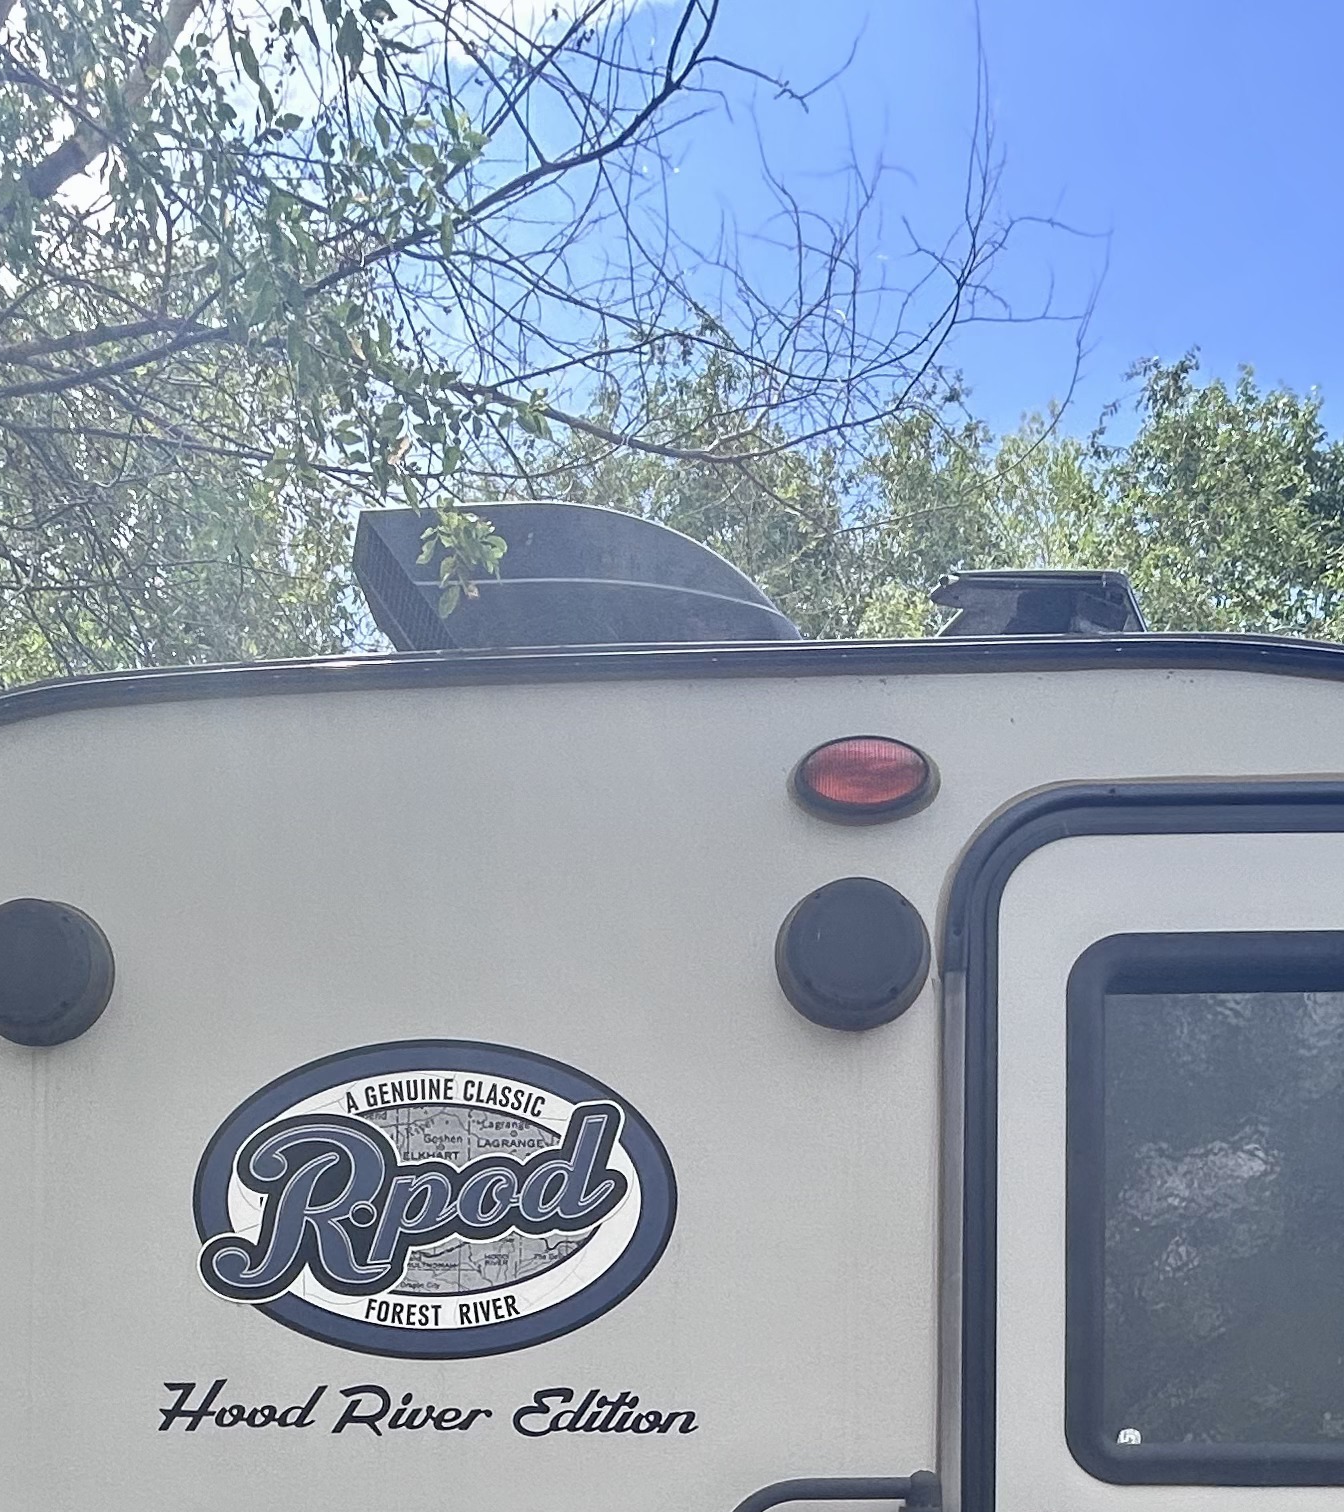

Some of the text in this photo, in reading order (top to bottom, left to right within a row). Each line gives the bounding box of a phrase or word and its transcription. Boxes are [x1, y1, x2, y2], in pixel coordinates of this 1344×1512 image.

[345, 1078, 546, 1118] A GENUINE CLASSIC
[423, 1134, 464, 1144] Goshen
[477, 1139, 544, 1148] LAGRANGE
[402, 1151, 461, 1161] ELKHART
[365, 1295, 520, 1326] FOREST RIVER
[158, 1379, 699, 1437] Hood River Edition
